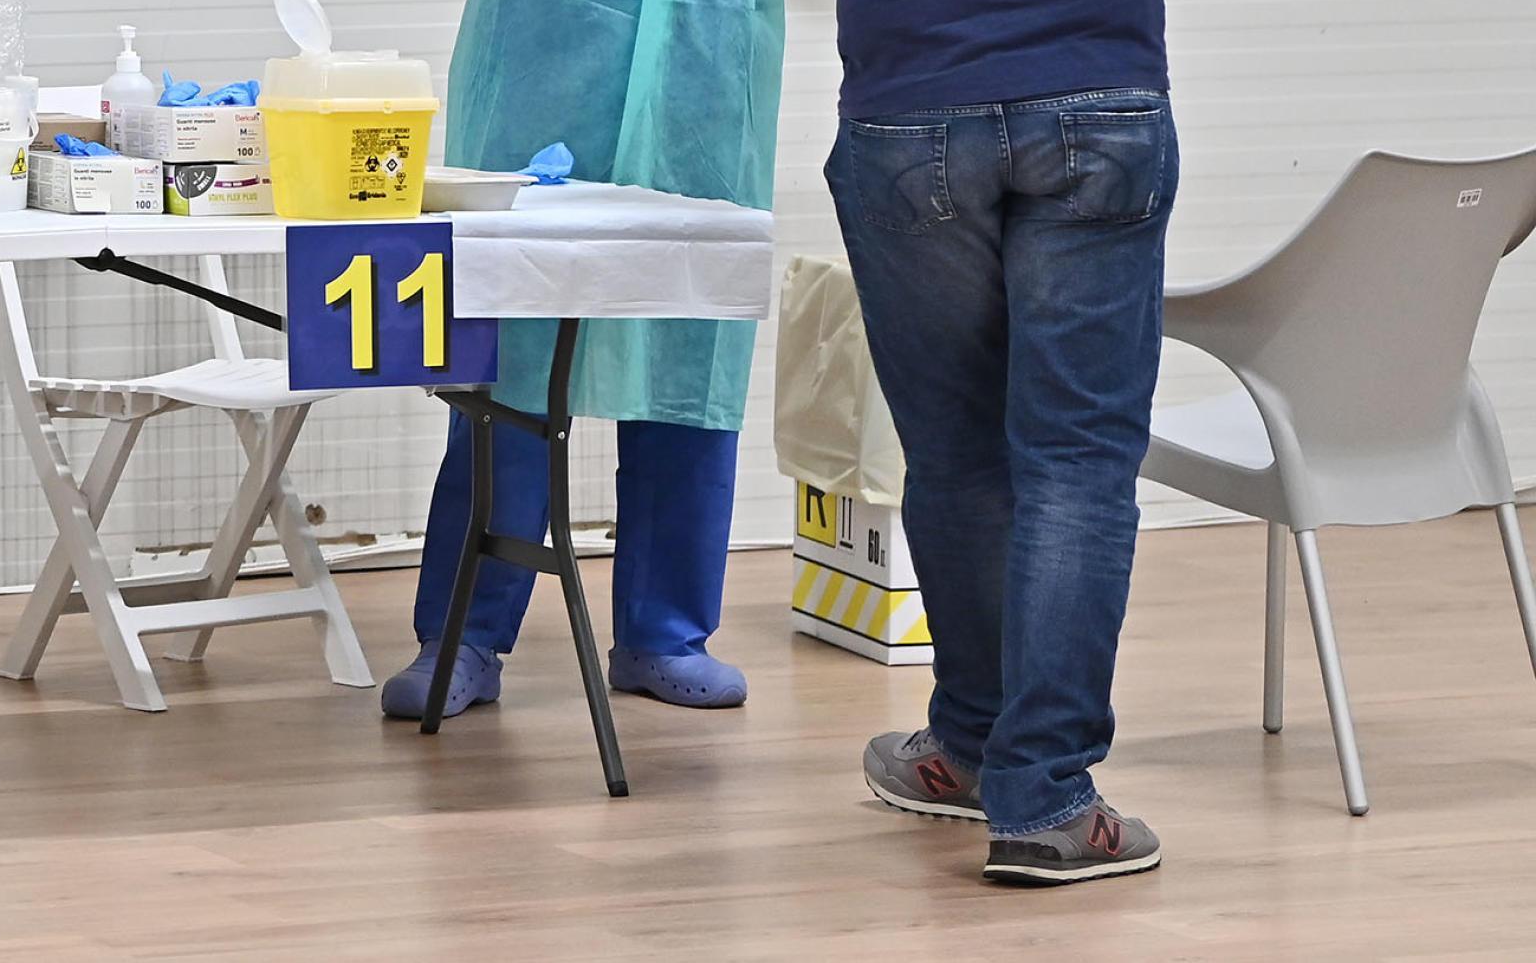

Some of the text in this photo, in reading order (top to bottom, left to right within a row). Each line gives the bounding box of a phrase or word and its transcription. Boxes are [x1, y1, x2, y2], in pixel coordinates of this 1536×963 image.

[237, 147, 254, 156] 100
[135, 200, 151, 209] 100
[324, 252, 444, 371] 11
[806, 483, 827, 528] R
[868, 528, 880, 565] 60
[916, 757, 962, 797] N
[1087, 812, 1122, 855] N
